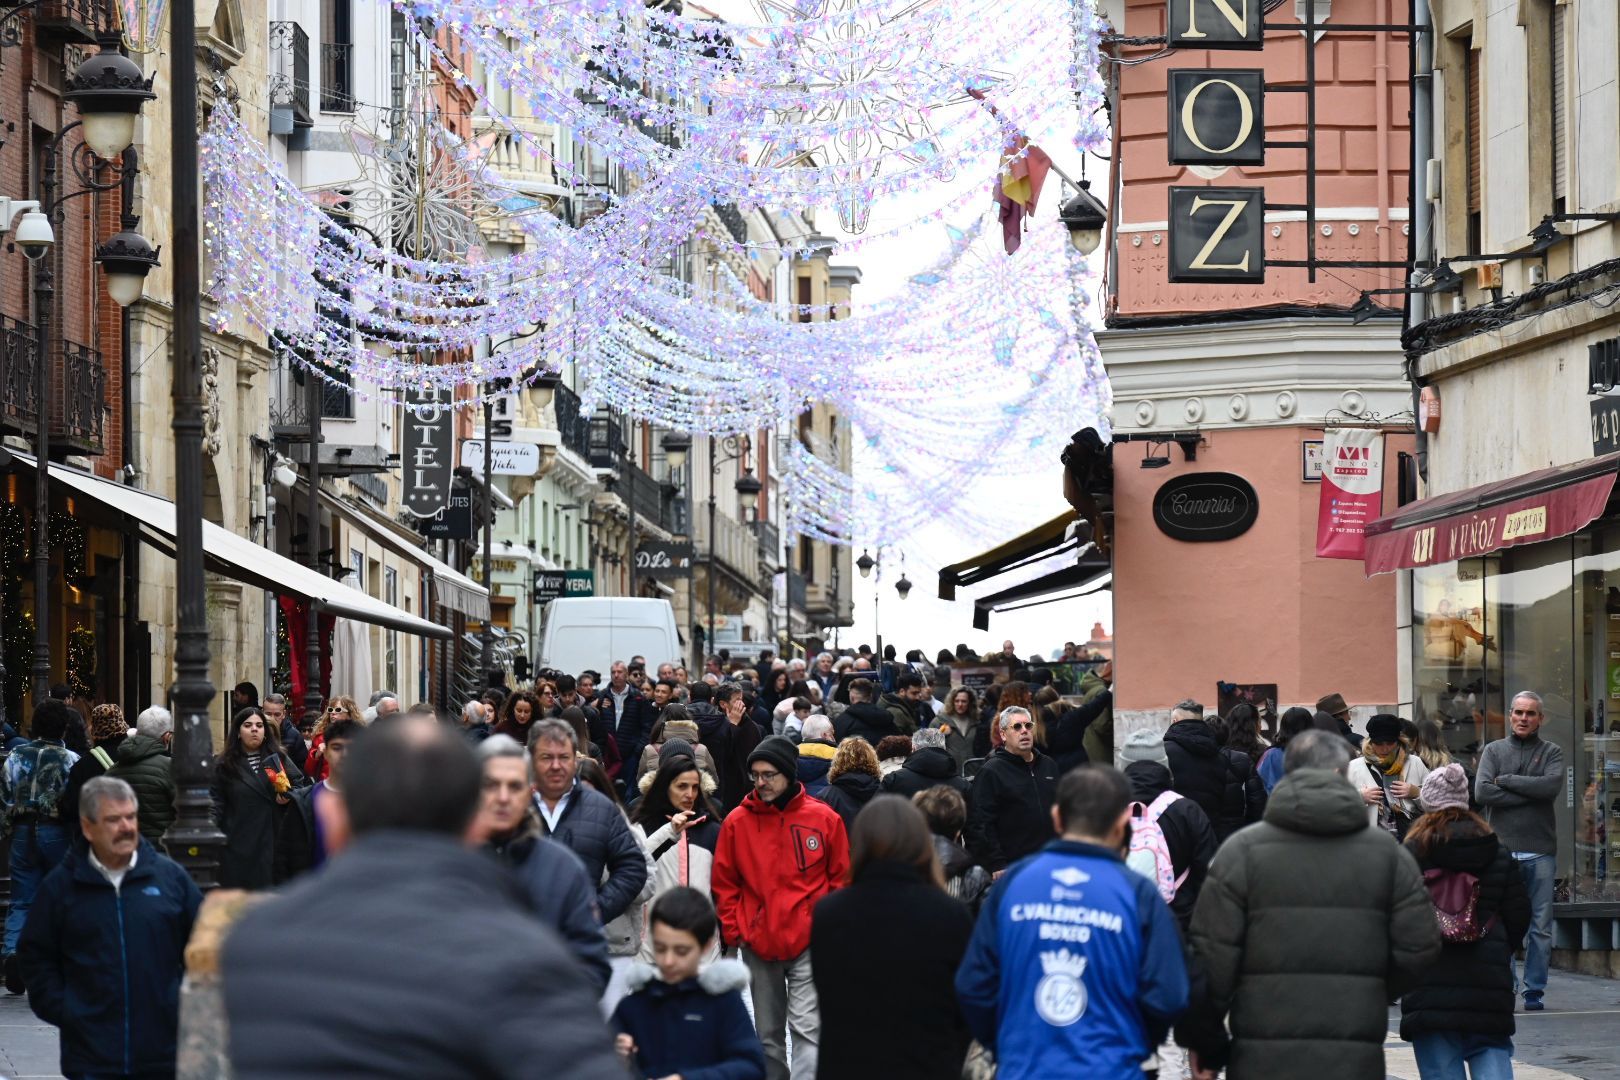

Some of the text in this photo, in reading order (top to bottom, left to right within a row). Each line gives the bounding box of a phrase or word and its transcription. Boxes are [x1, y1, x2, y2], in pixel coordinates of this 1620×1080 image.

[412, 380, 443, 490] HOTEL
[1171, 493, 1237, 515] Canarias
[565, 578, 593, 591] YERIA
[1039, 922, 1091, 943] BOXEO
